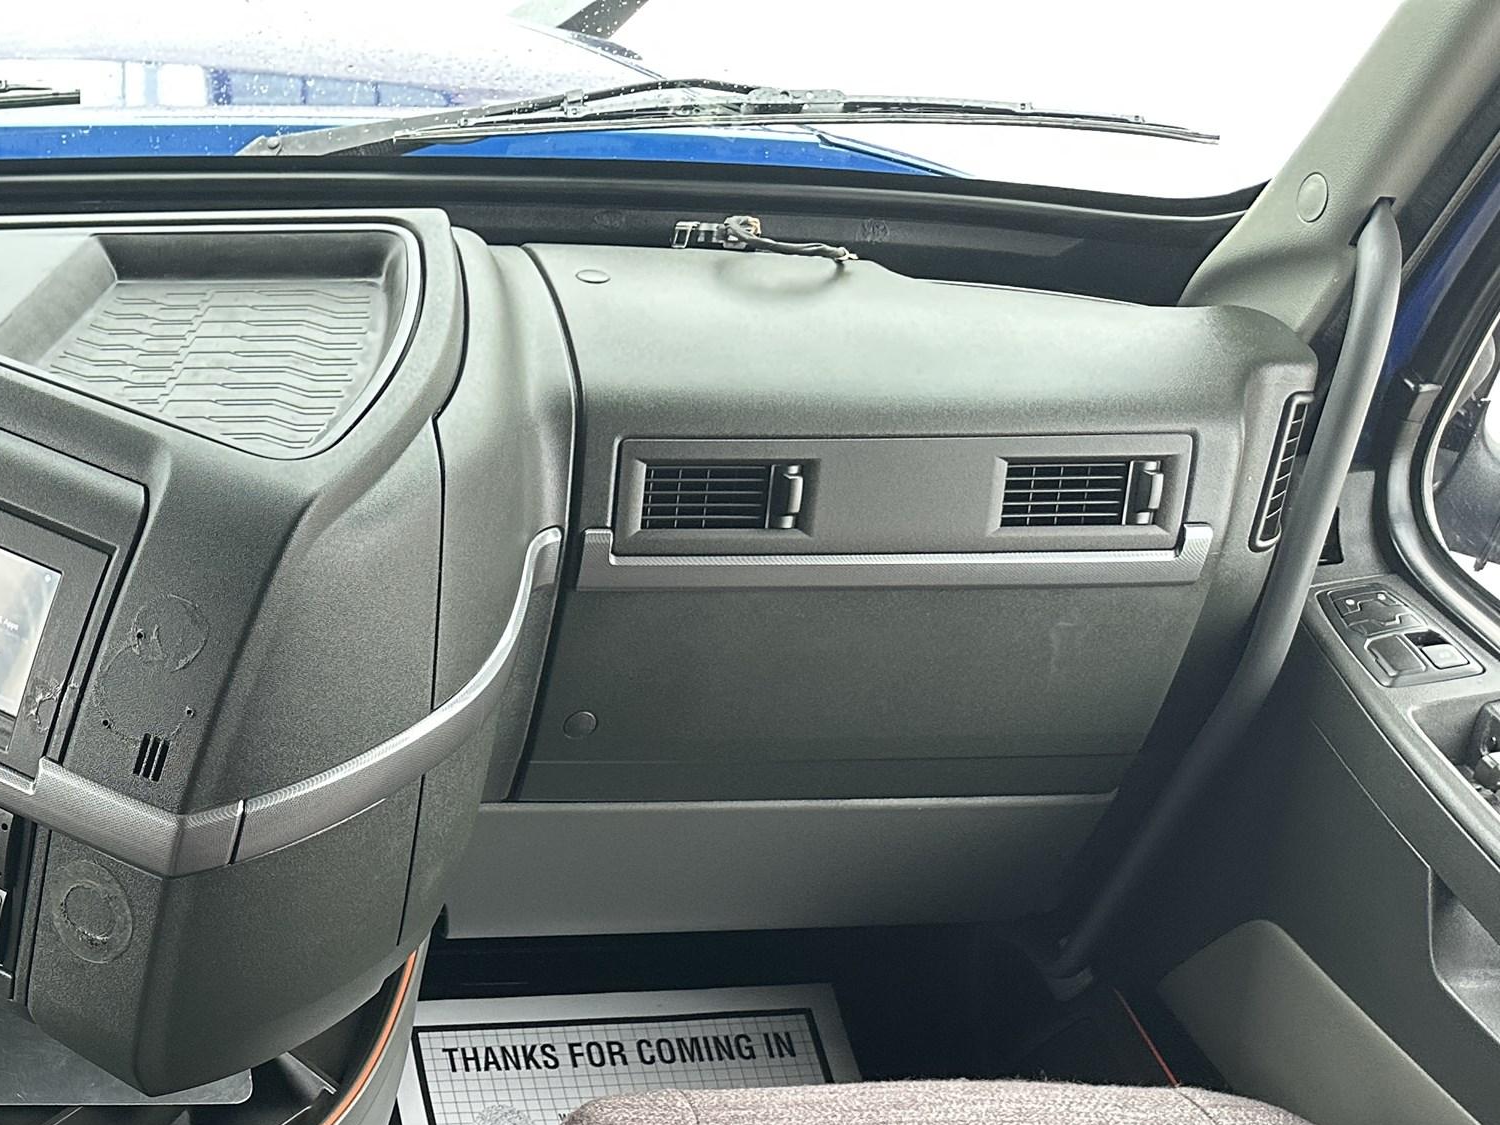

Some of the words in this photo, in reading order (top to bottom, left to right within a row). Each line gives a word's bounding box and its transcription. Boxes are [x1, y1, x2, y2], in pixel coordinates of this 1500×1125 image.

[442, 1043, 560, 1073] THANKS
[567, 1040, 628, 1068] FOR
[636, 1034, 756, 1065] COMING
[763, 1031, 797, 1059] IN
